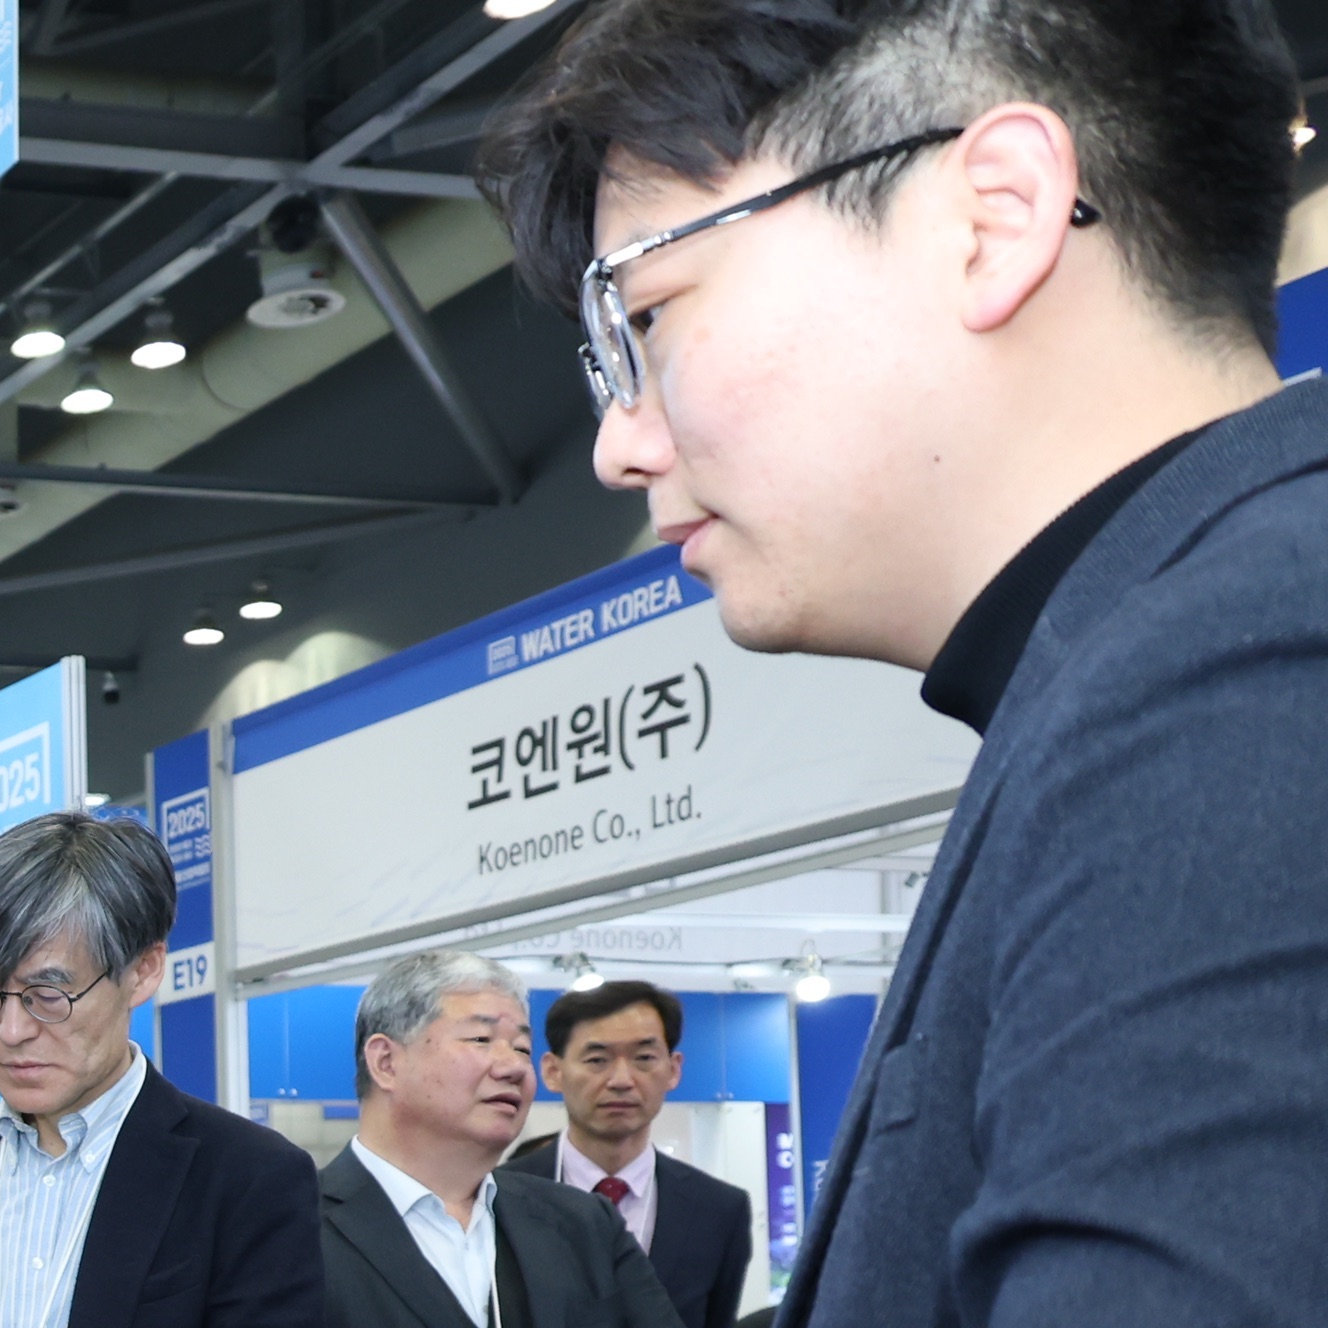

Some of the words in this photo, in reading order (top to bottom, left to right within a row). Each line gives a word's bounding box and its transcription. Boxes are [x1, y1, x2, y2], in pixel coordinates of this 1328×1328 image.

[519, 608, 596, 663] WATER
[600, 574, 684, 633] KOREA
[467, 661, 712, 811] 코엔원(주)
[167, 801, 205, 840] 2025
[478, 823, 584, 876] Koenone
[592, 808, 642, 842] Co.,
[651, 784, 703, 830] Ltd.
[173, 954, 208, 991] E19
